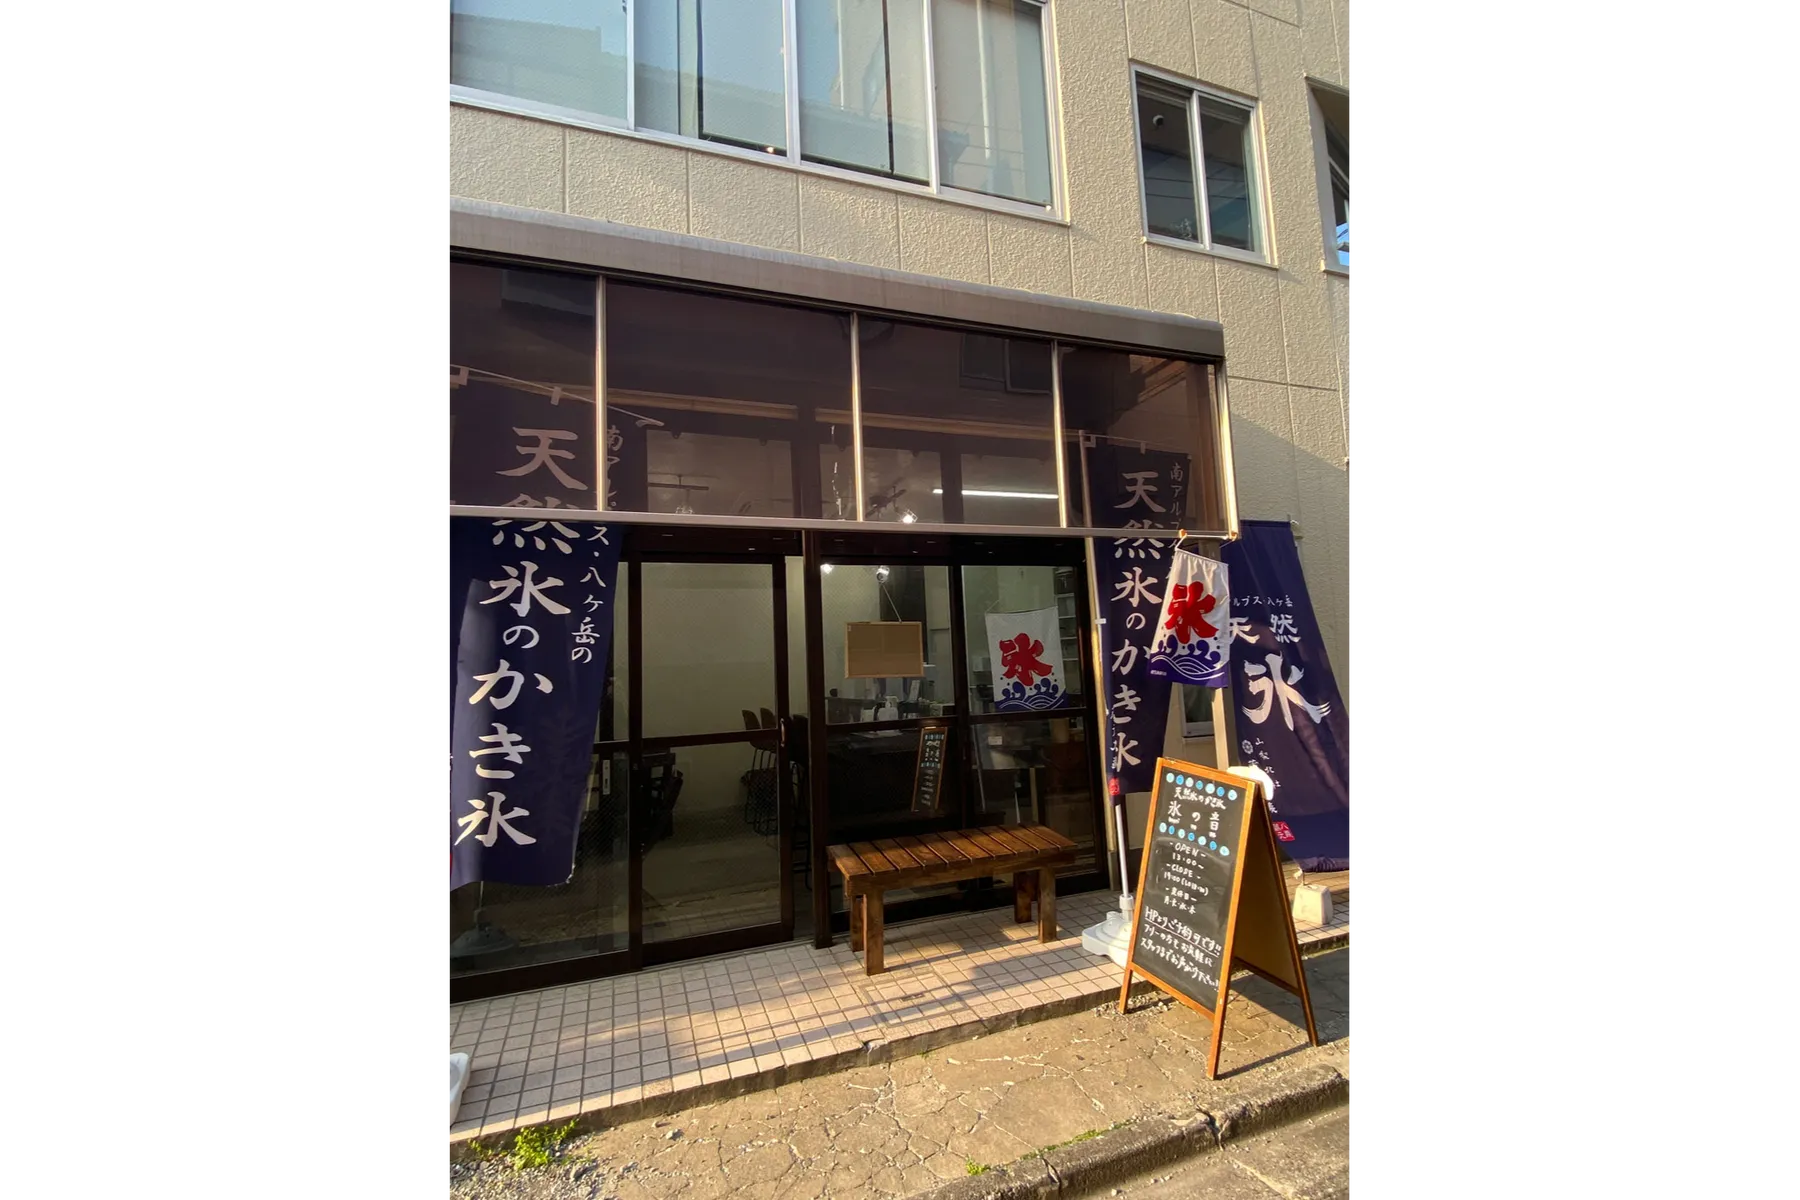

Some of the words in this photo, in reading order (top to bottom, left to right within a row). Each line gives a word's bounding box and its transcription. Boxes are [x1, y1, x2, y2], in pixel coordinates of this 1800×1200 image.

[454, 426, 587, 848] 天然氷のかき氷
[1163, 580, 1220, 645] 氷
[1230, 613, 1302, 645] 天然
[998, 632, 1054, 687] 氷
[1242, 649, 1332, 732] 氷
